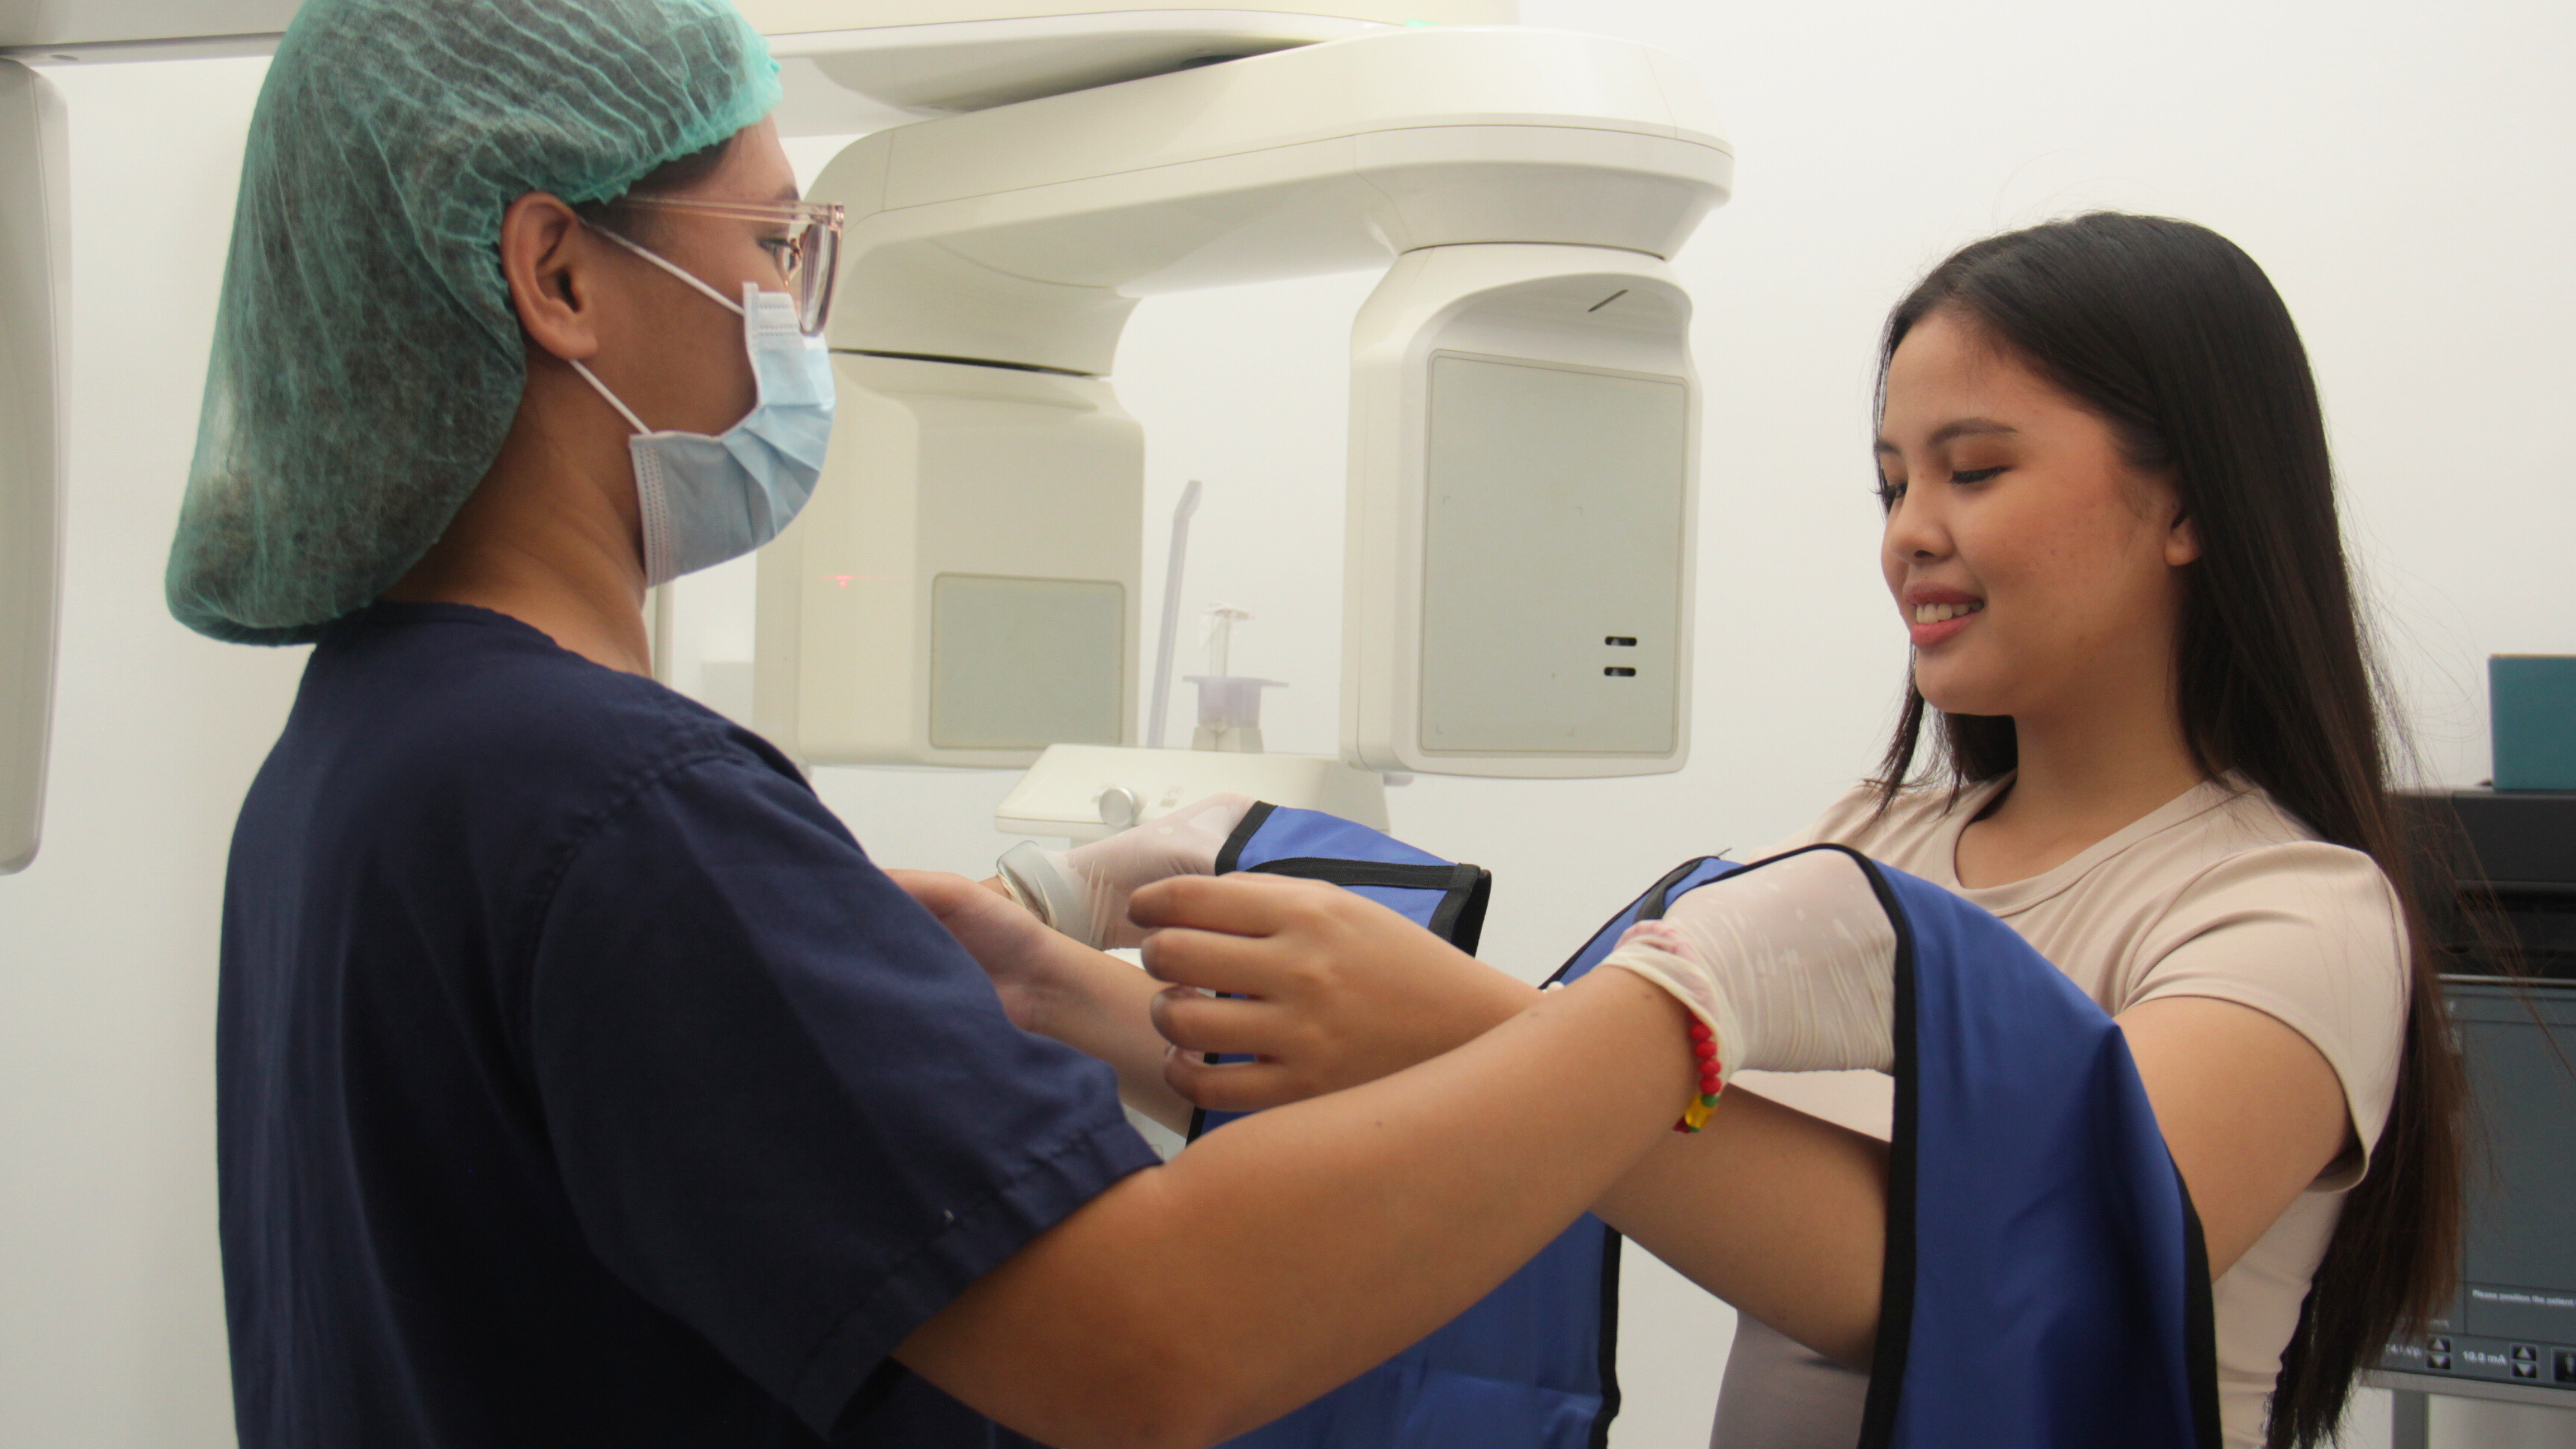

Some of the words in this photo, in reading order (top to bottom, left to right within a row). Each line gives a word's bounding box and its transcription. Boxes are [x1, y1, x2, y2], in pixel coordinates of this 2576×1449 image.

[2472, 1289, 2497, 1300] Please
[2499, 1293, 2530, 1302] position
[2532, 1295, 2544, 1303] the
[2546, 1297, 2574, 1307] patient
[2463, 1350, 2486, 1362] 10.0
[2487, 1354, 2506, 1365] mA
